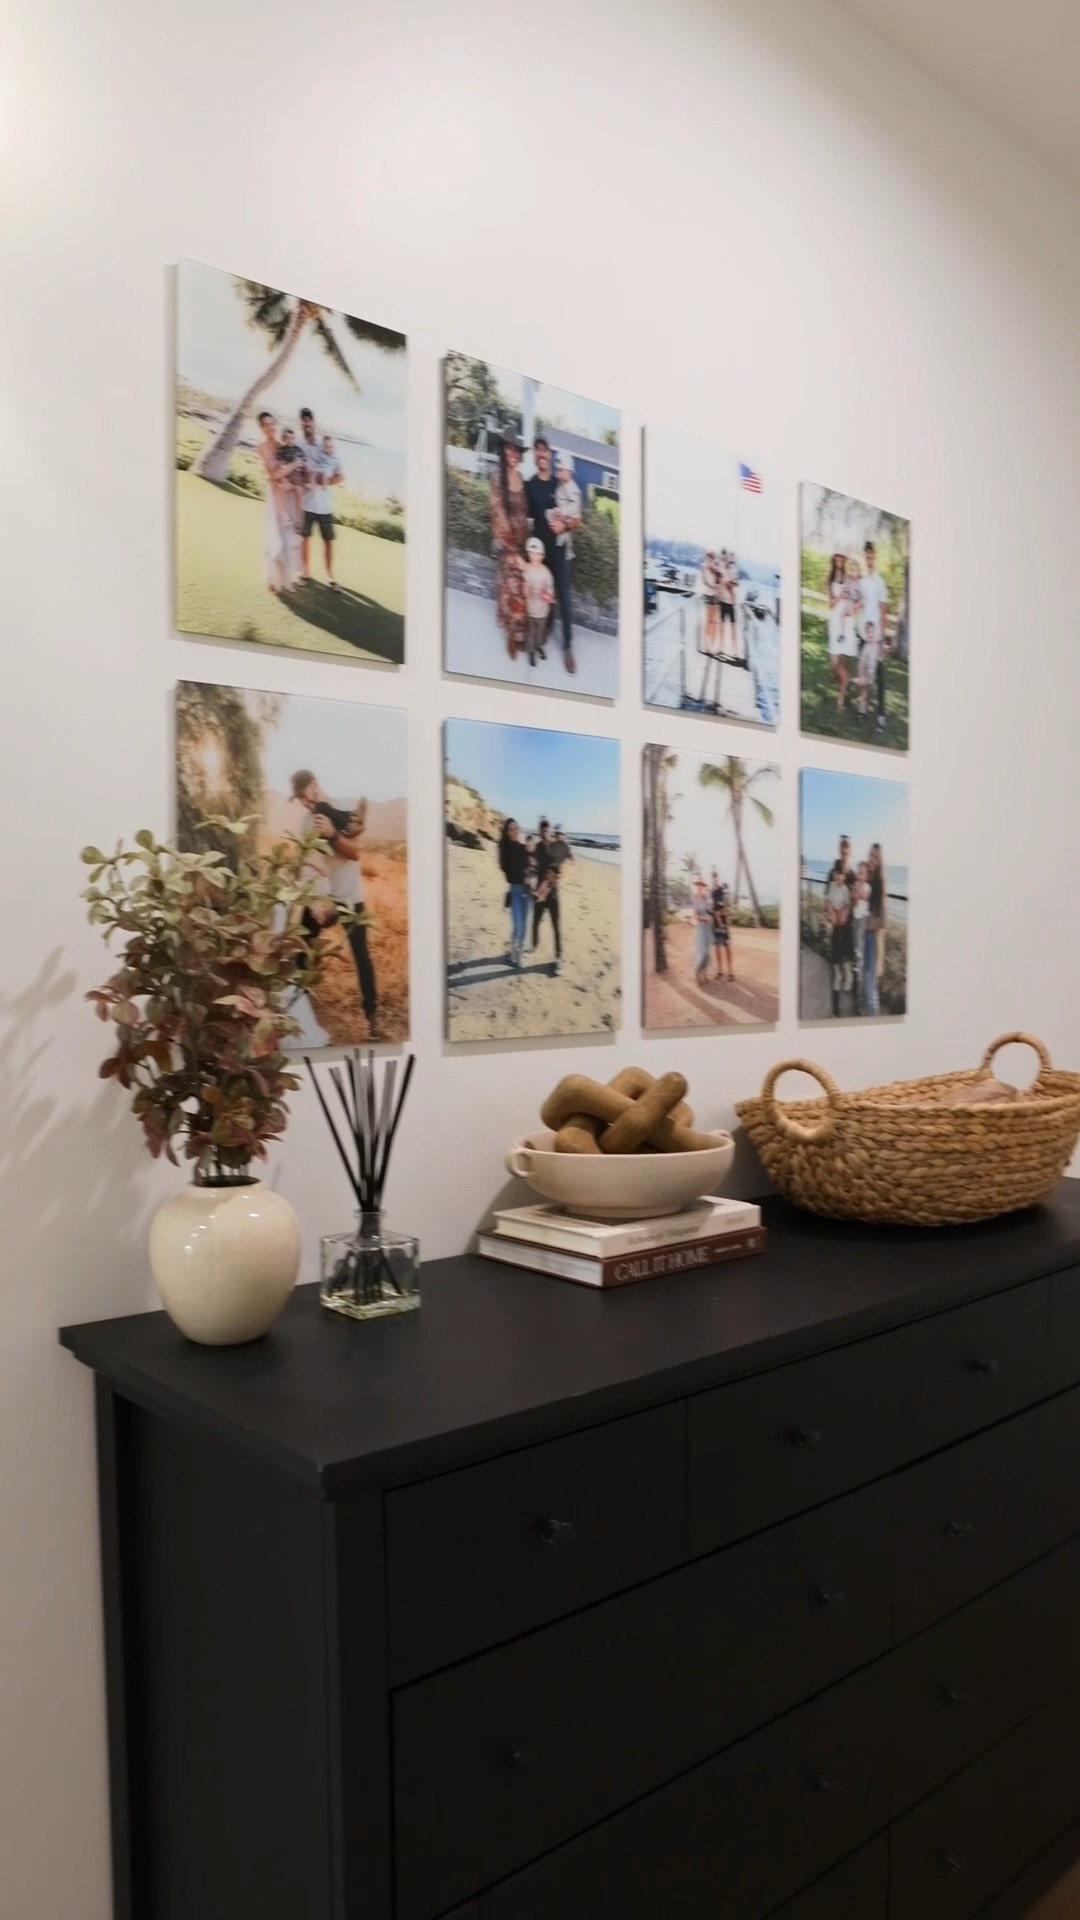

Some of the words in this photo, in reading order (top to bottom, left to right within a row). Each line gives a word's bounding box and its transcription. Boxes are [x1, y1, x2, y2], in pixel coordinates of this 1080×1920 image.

[614, 1260, 652, 1281] CALL
[653, 1255, 668, 1273] IT
[667, 1246, 710, 1270] HOME
